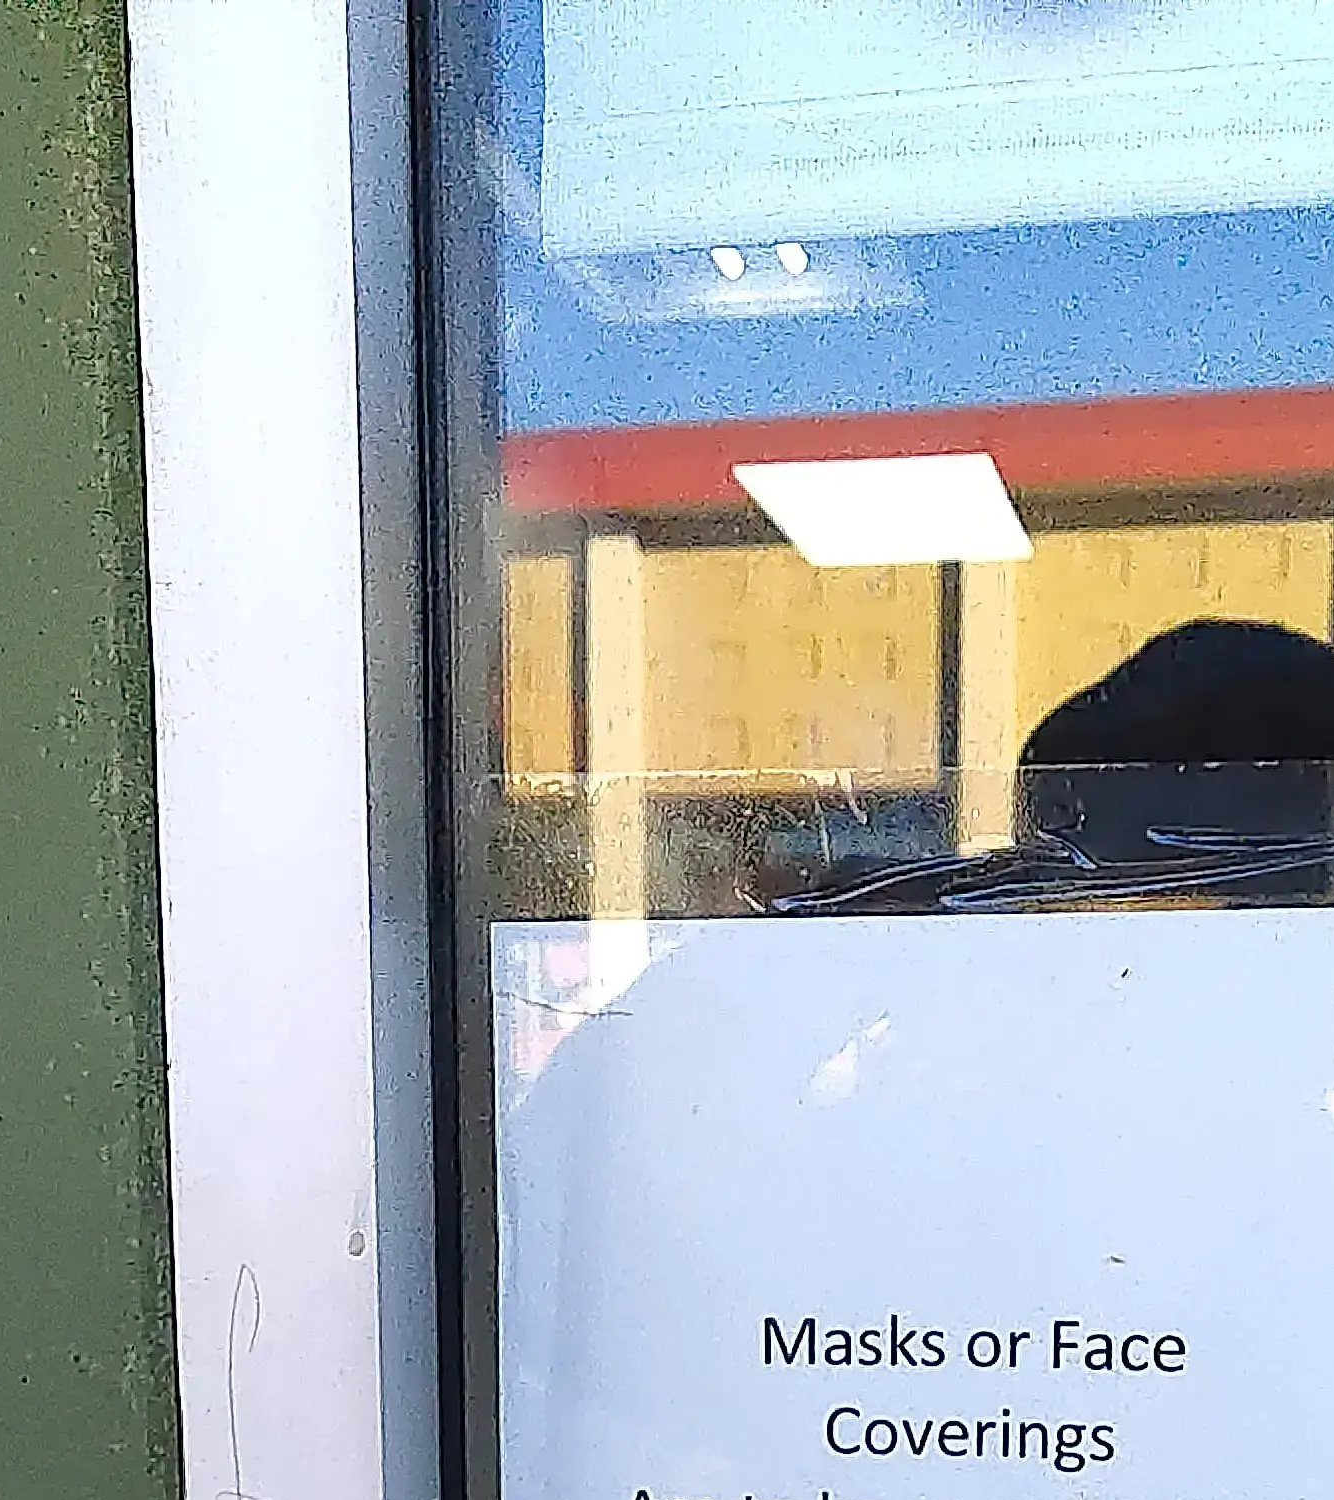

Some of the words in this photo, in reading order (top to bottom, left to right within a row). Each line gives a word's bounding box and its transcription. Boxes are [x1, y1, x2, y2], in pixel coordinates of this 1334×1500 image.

[762, 1313, 946, 1368] Masks
[967, 1330, 1031, 1369] or
[1052, 1319, 1187, 1373] Face
[826, 1406, 1116, 1473] Coverings
